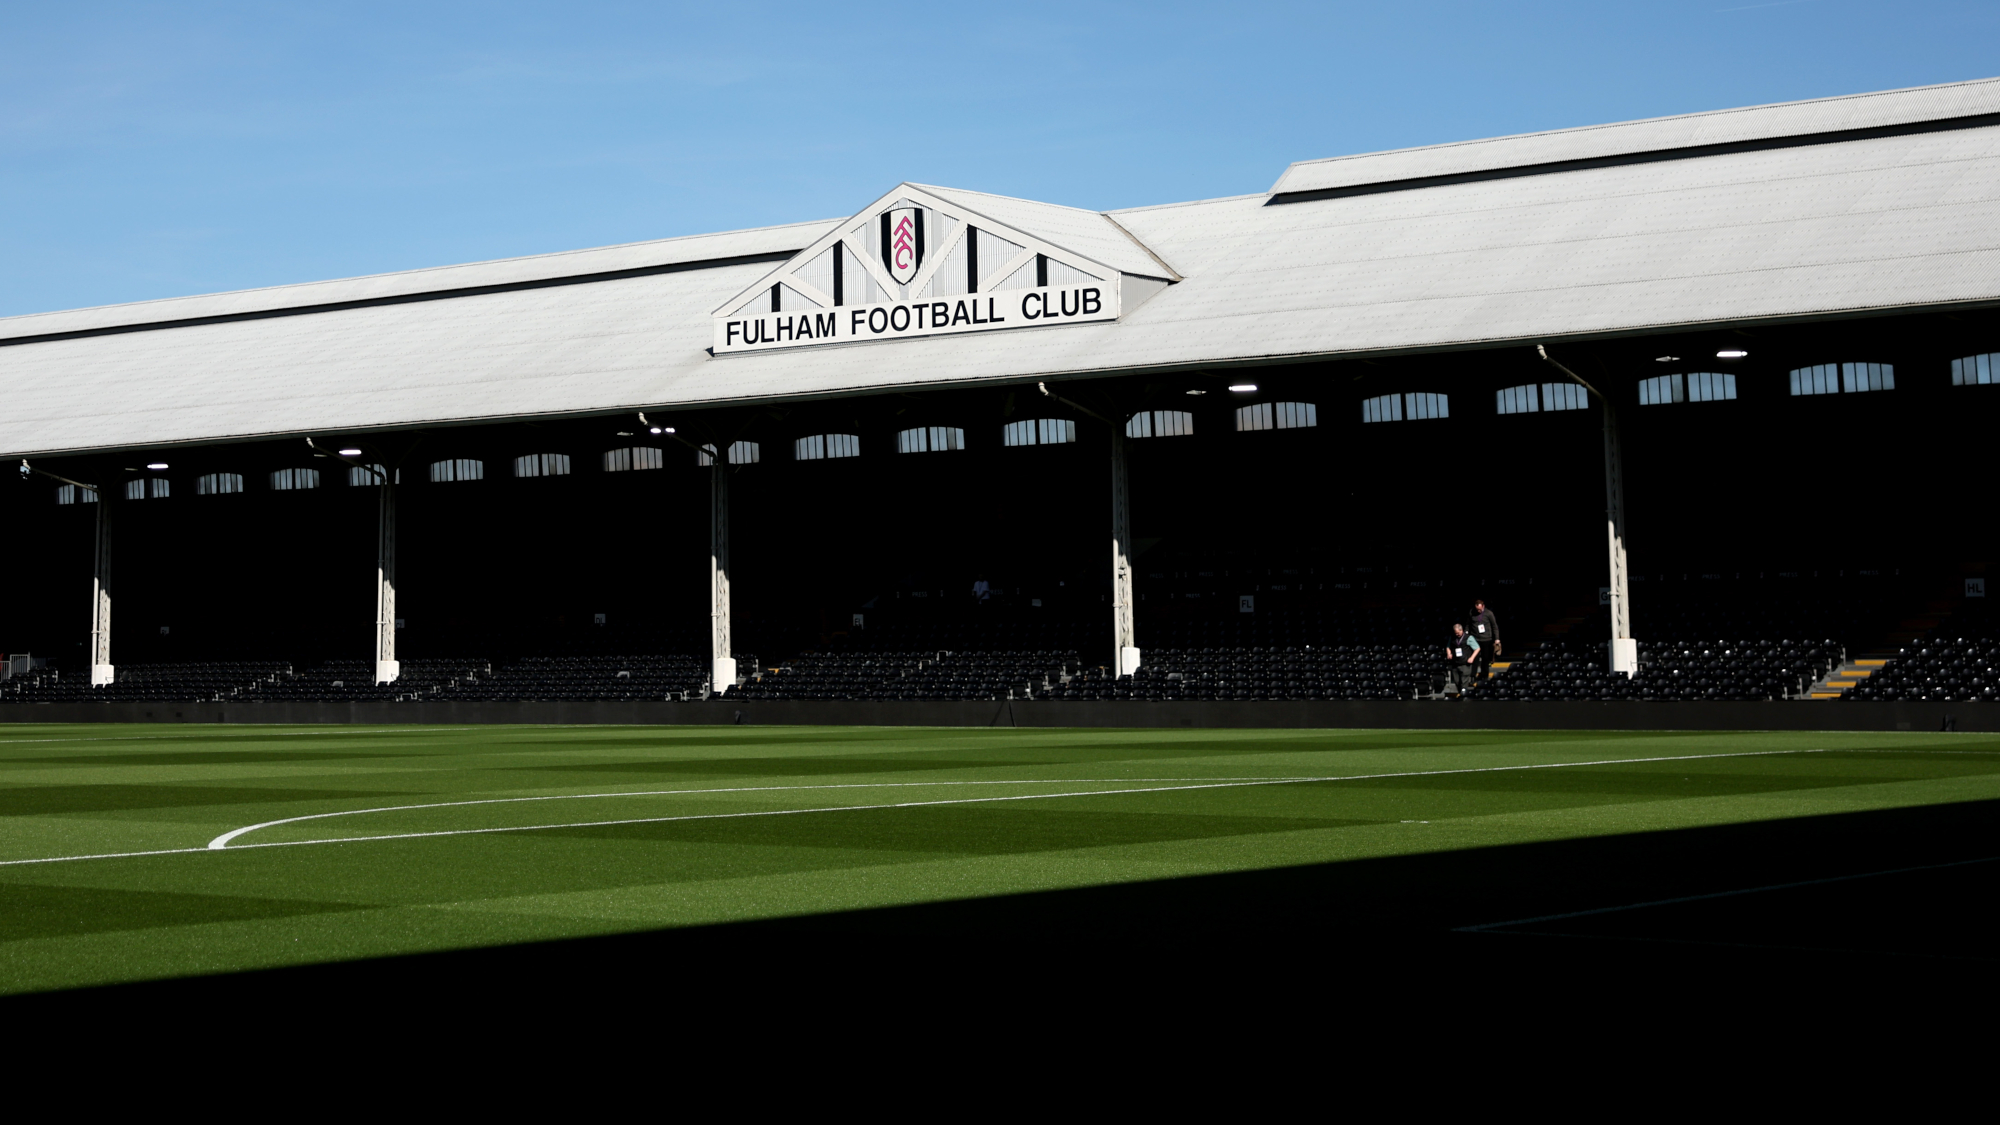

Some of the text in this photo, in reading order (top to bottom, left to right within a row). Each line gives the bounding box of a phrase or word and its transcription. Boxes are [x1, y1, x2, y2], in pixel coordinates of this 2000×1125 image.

[726, 287, 1102, 346] FULHAM FOOTBALL CLUB
[1968, 583, 1982, 593] HL
[1601, 592, 1611, 601] G
[1241, 599, 1252, 609] FL
